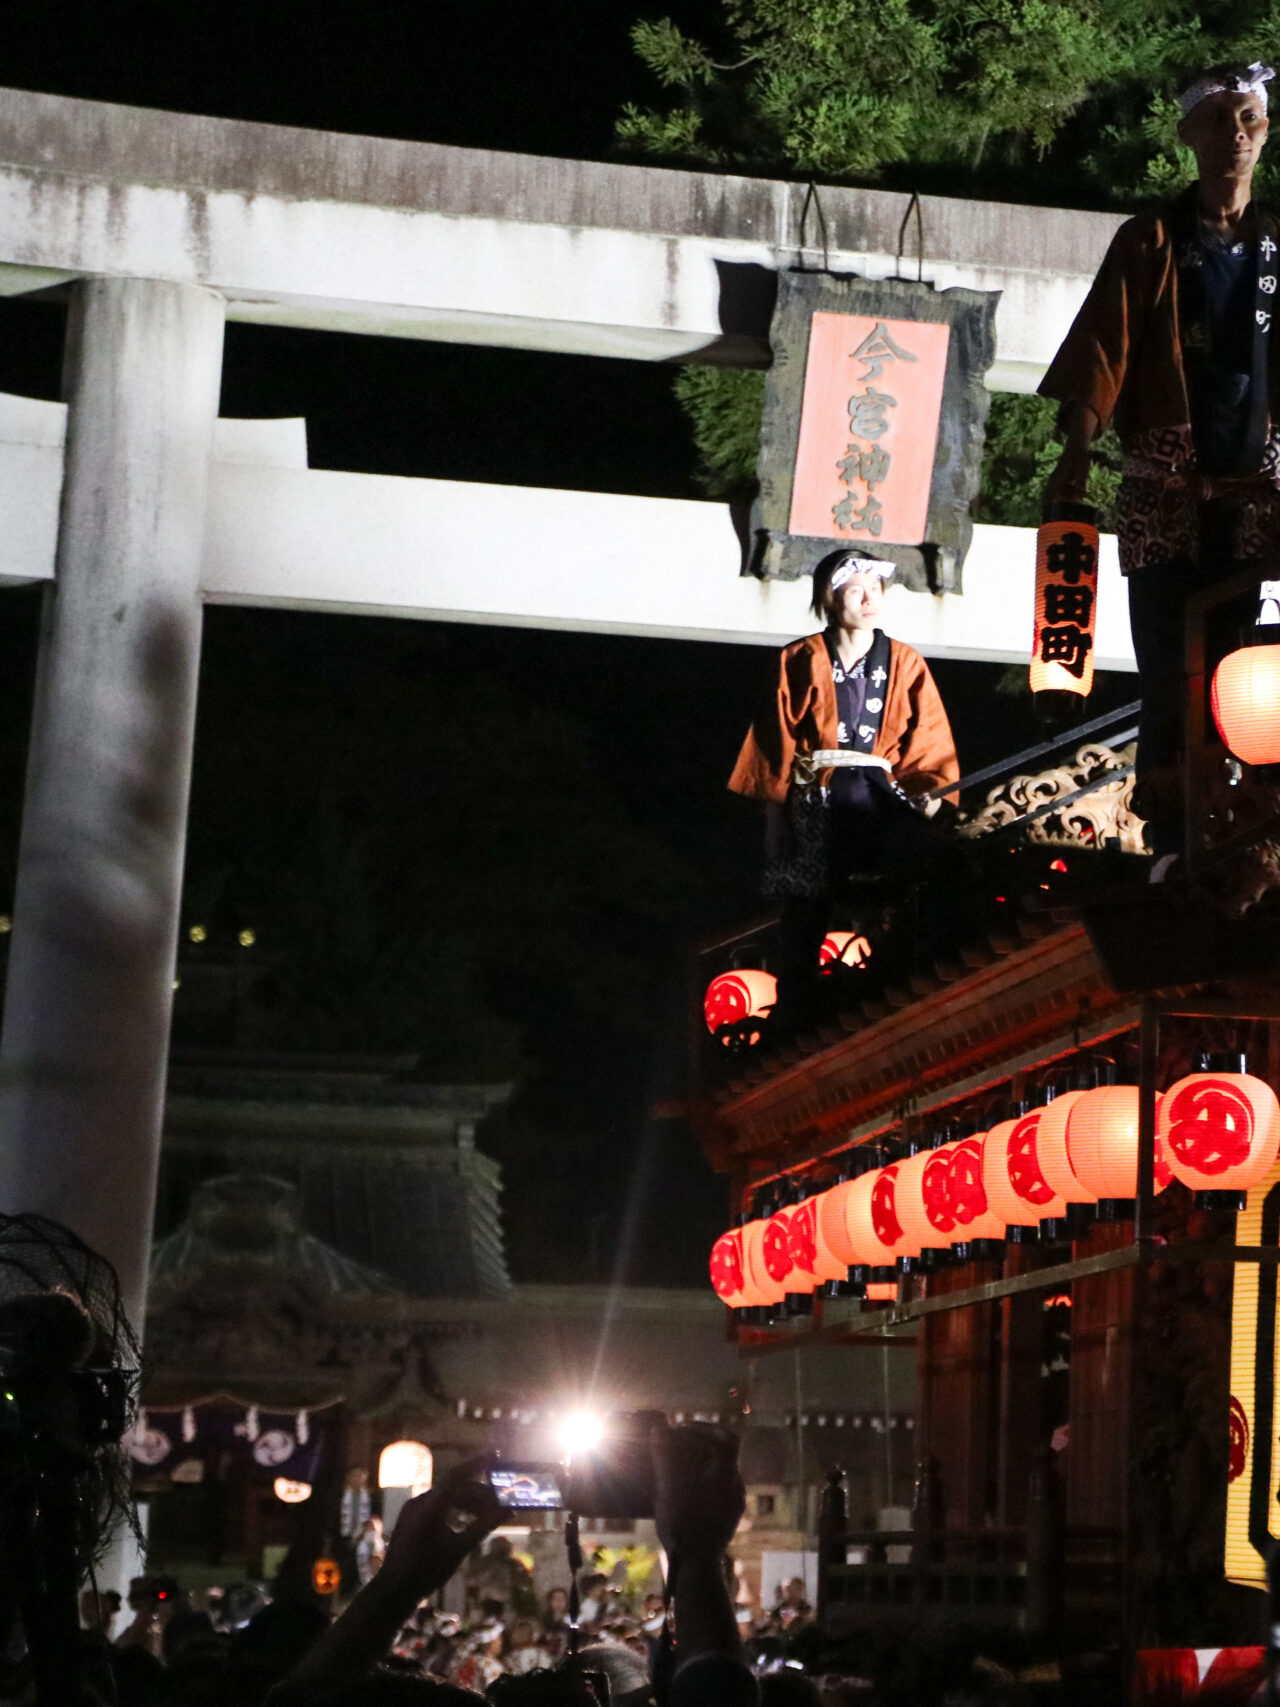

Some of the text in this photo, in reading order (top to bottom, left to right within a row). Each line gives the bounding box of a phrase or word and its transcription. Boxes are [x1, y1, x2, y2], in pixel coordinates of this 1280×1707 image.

[1255, 235, 1278, 333] 中田町
[831, 321, 919, 537] 今宮神社
[1041, 531, 1096, 679] 中田町
[858, 665, 889, 744] 中田町
